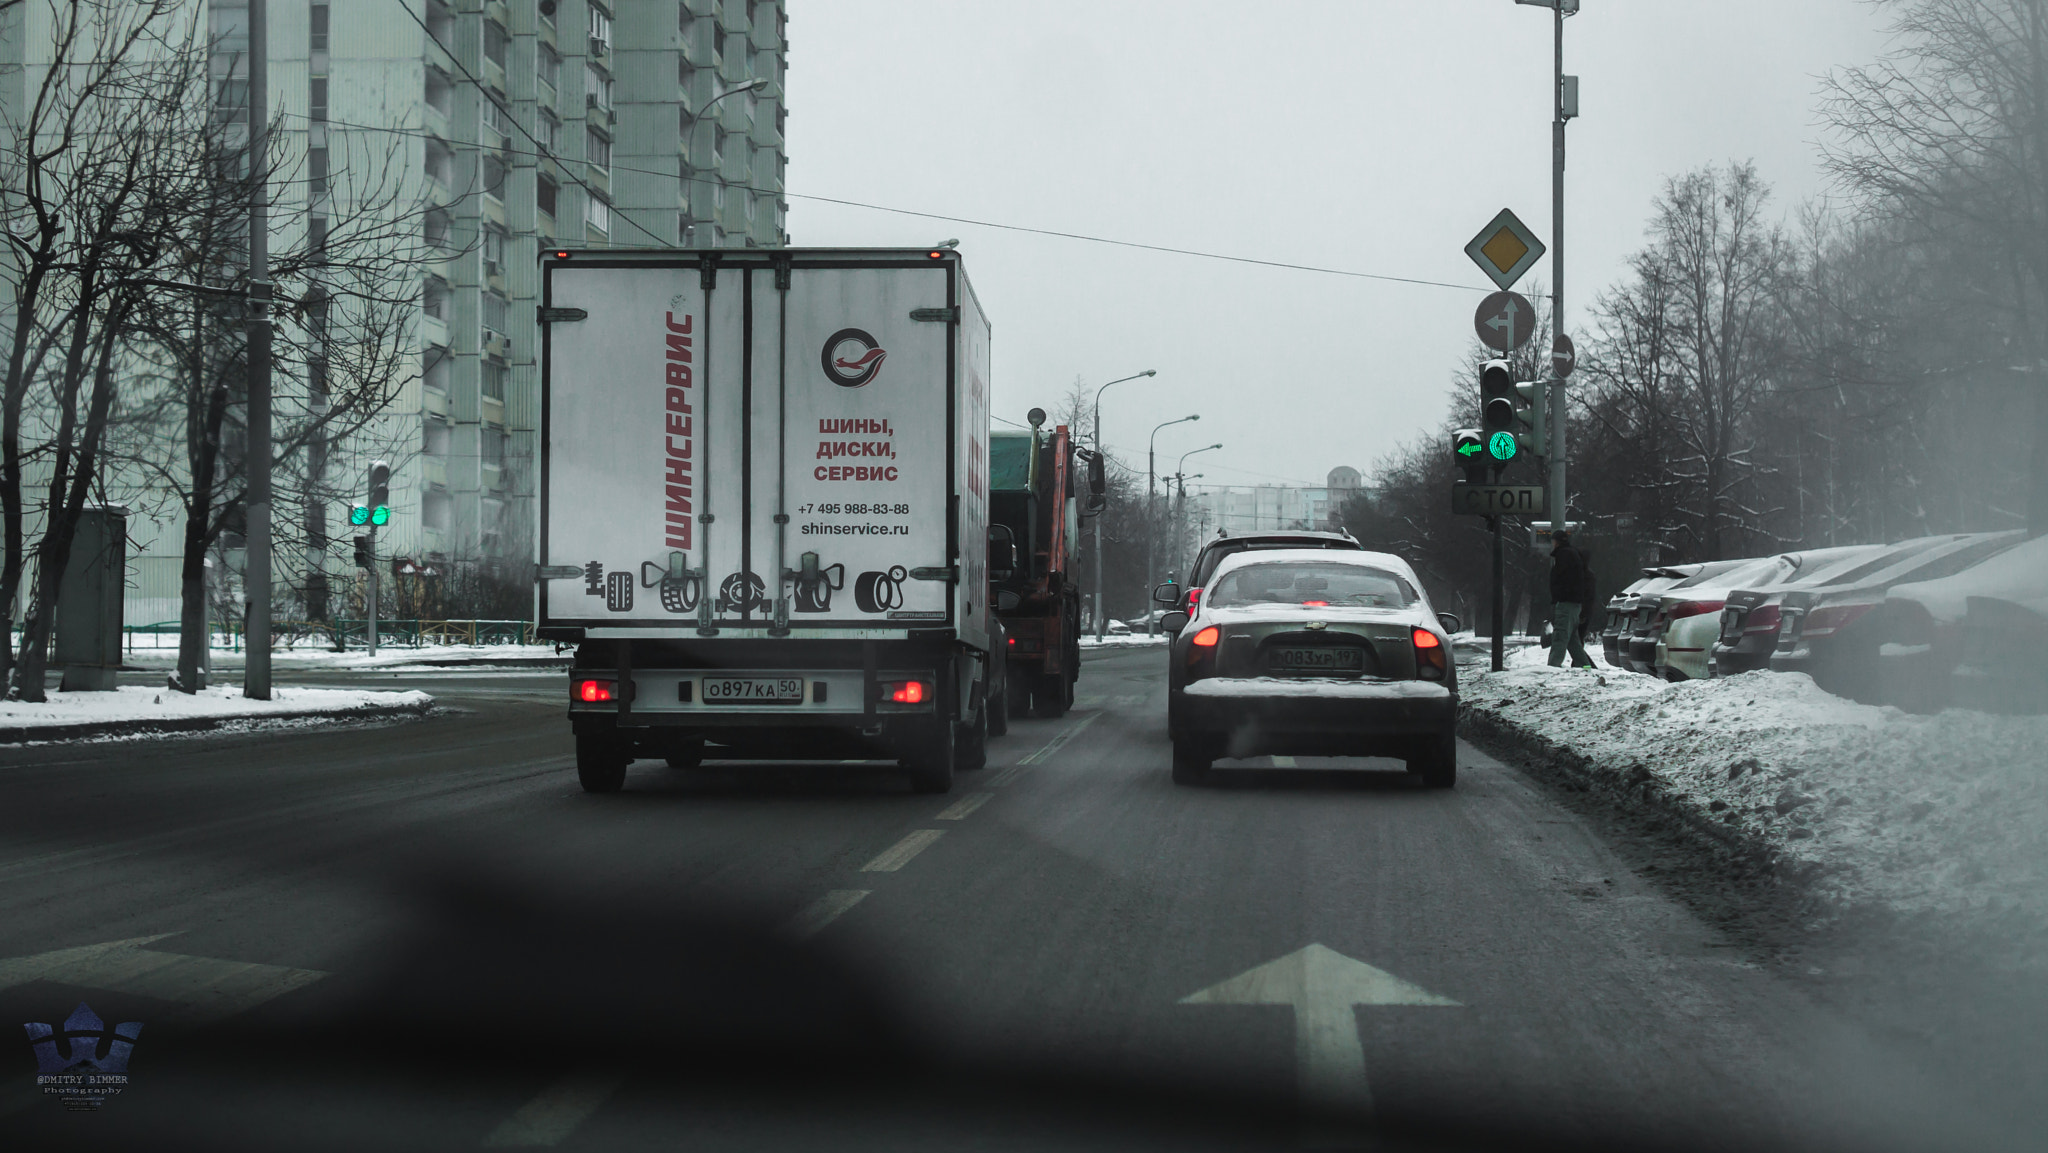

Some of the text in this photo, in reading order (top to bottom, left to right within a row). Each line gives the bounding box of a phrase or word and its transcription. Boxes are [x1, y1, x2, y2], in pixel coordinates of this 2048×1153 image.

[665, 311, 692, 550] ШИНСЕРВИС
[819, 418, 893, 437] ШИНЫ,
[816, 441, 896, 460] ДИСКИ,
[814, 466, 898, 481] СЕРВИС
[1466, 490, 1532, 509] СТОП
[798, 503, 910, 514] +7 495 988-83-88
[801, 522, 909, 535] shinservice.ru
[780, 680, 796, 692] 50
